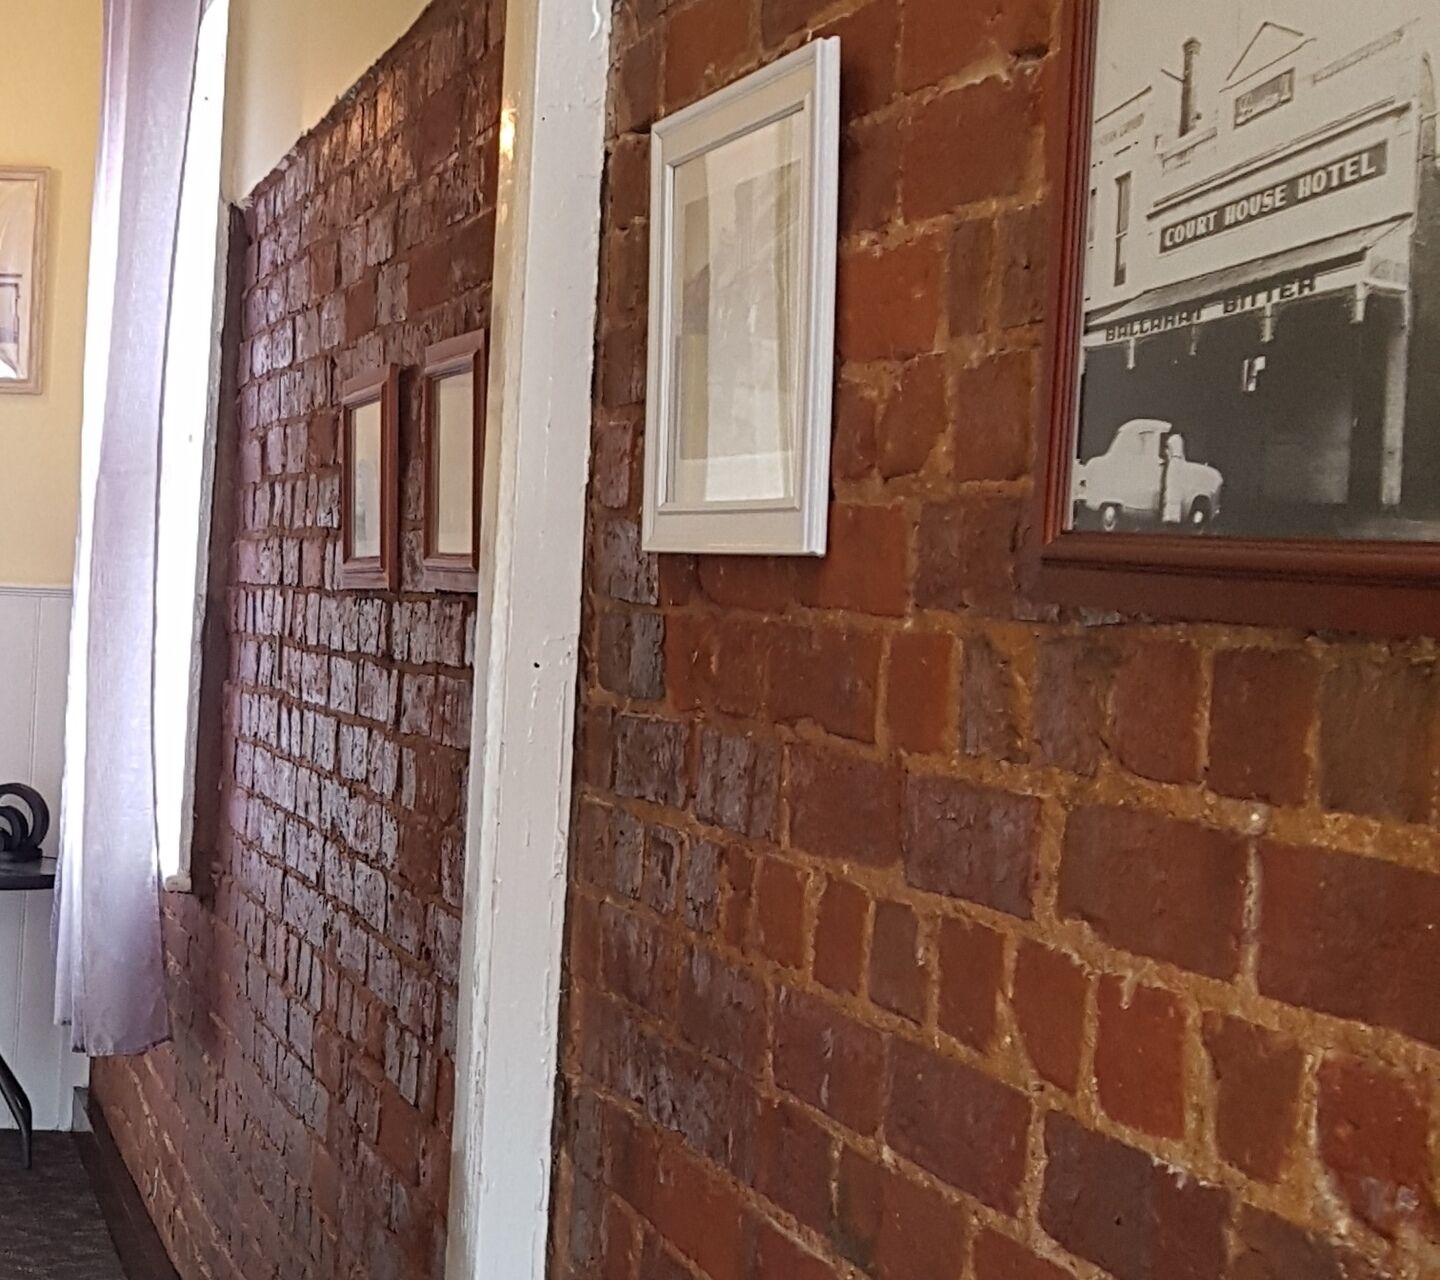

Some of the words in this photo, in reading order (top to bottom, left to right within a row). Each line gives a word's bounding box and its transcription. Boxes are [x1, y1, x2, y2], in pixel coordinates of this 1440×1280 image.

[1164, 213, 1217, 247] COURT
[1224, 184, 1288, 226] HOUSE
[1297, 152, 1377, 199] HOTEL
[1223, 278, 1315, 314] BITTER
